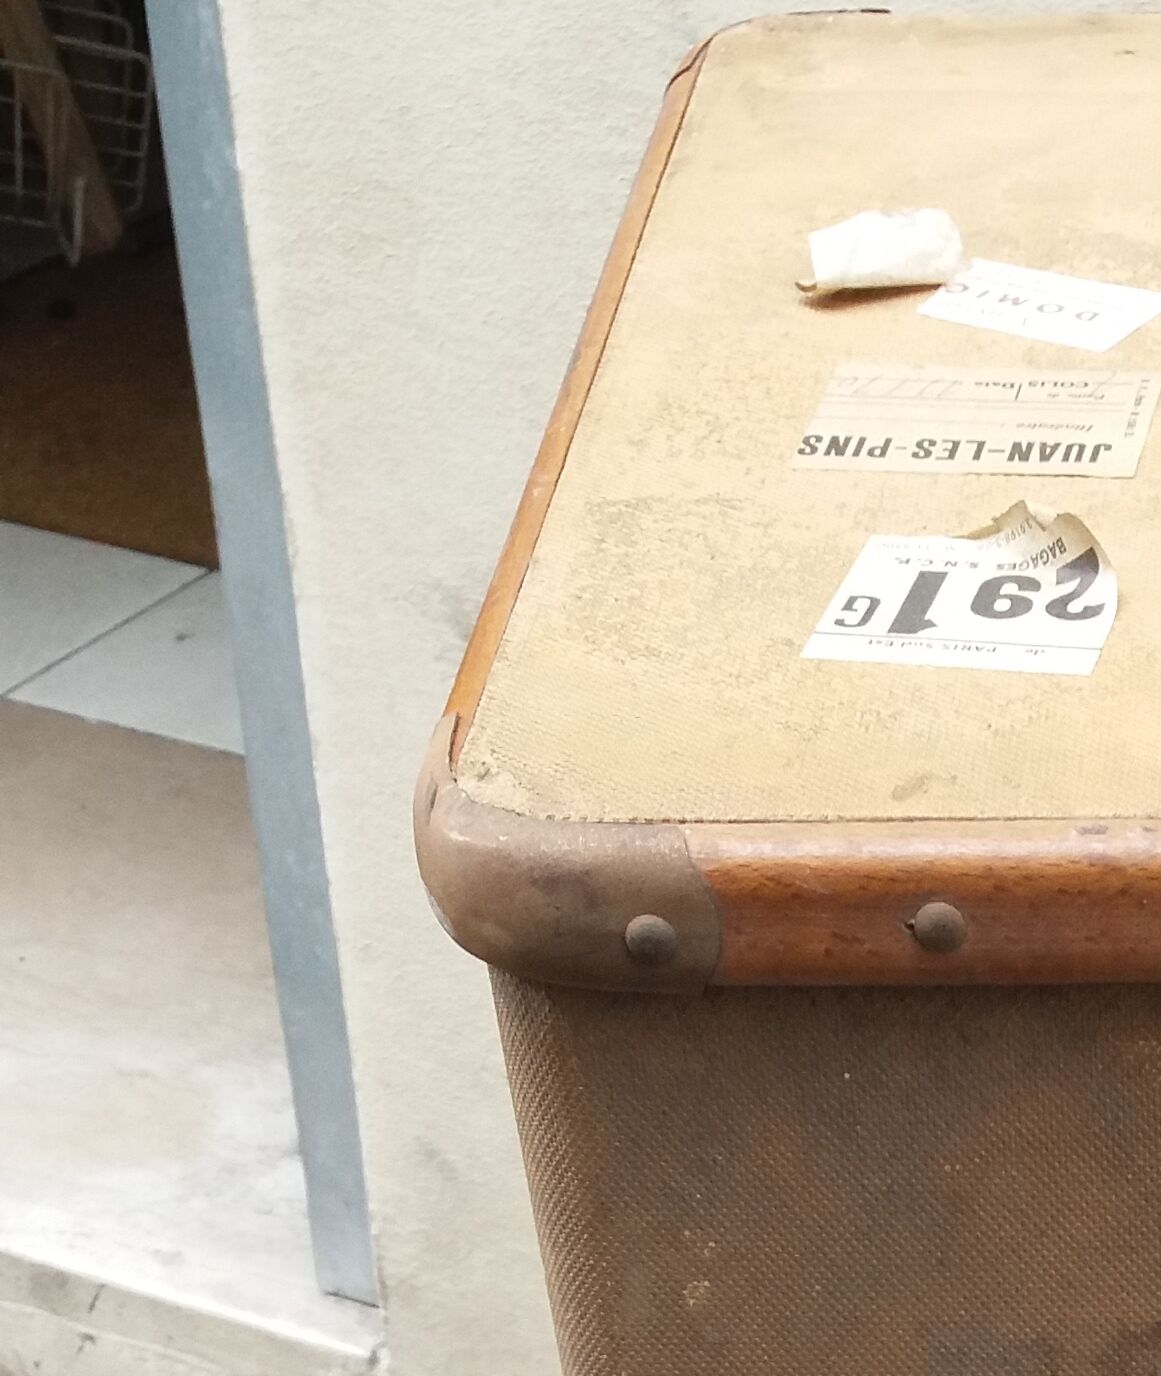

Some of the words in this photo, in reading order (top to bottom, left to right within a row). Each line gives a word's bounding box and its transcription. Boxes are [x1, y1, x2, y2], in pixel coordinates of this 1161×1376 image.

[796, 433, 1113, 464] JUAN-LES-PINS
[995, 535, 1068, 572] BAGAGES
[886, 546, 1106, 635] 291
